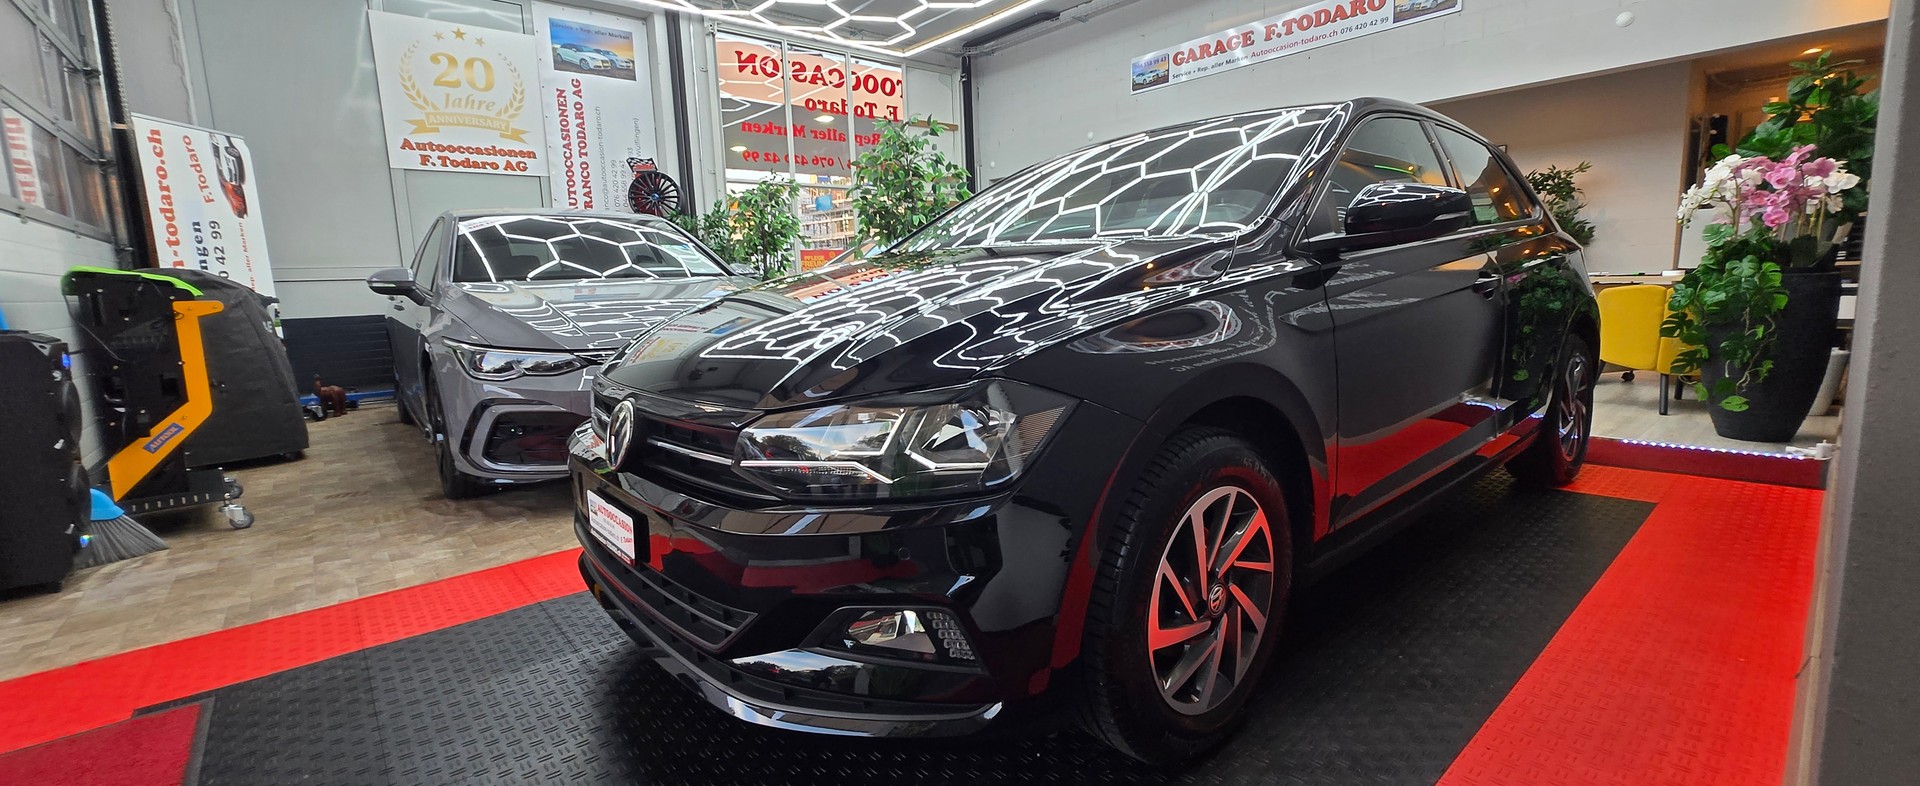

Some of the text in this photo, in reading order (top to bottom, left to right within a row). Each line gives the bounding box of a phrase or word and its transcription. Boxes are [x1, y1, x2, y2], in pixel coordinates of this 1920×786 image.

[1172, 70, 1191, 80] Service
[1225, 55, 1249, 66] Marken
[1251, 28, 1338, 59] Autooccasion-todaro.ch
[1340, 26, 1353, 35] 076
[1355, 22, 1368, 31] 420
[1369, 19, 1378, 27] 42
[1380, 16, 1389, 24] 99
[1173, 29, 1255, 67] GARAGE
[429, 52, 495, 92] 20
[571, 78, 583, 99] AG
[444, 92, 496, 112] Jahre
[428, 114, 508, 130] ANNIVERSARY
[574, 101, 588, 158] TODARO
[400, 138, 537, 159] Autooccasionen
[556, 88, 578, 209] UTOOCCASIONEN
[419, 154, 528, 172] F. Todaro AG
[209, 220, 222, 240] 99
[239, 222, 249, 253] Marken
[213, 246, 227, 265] 42
